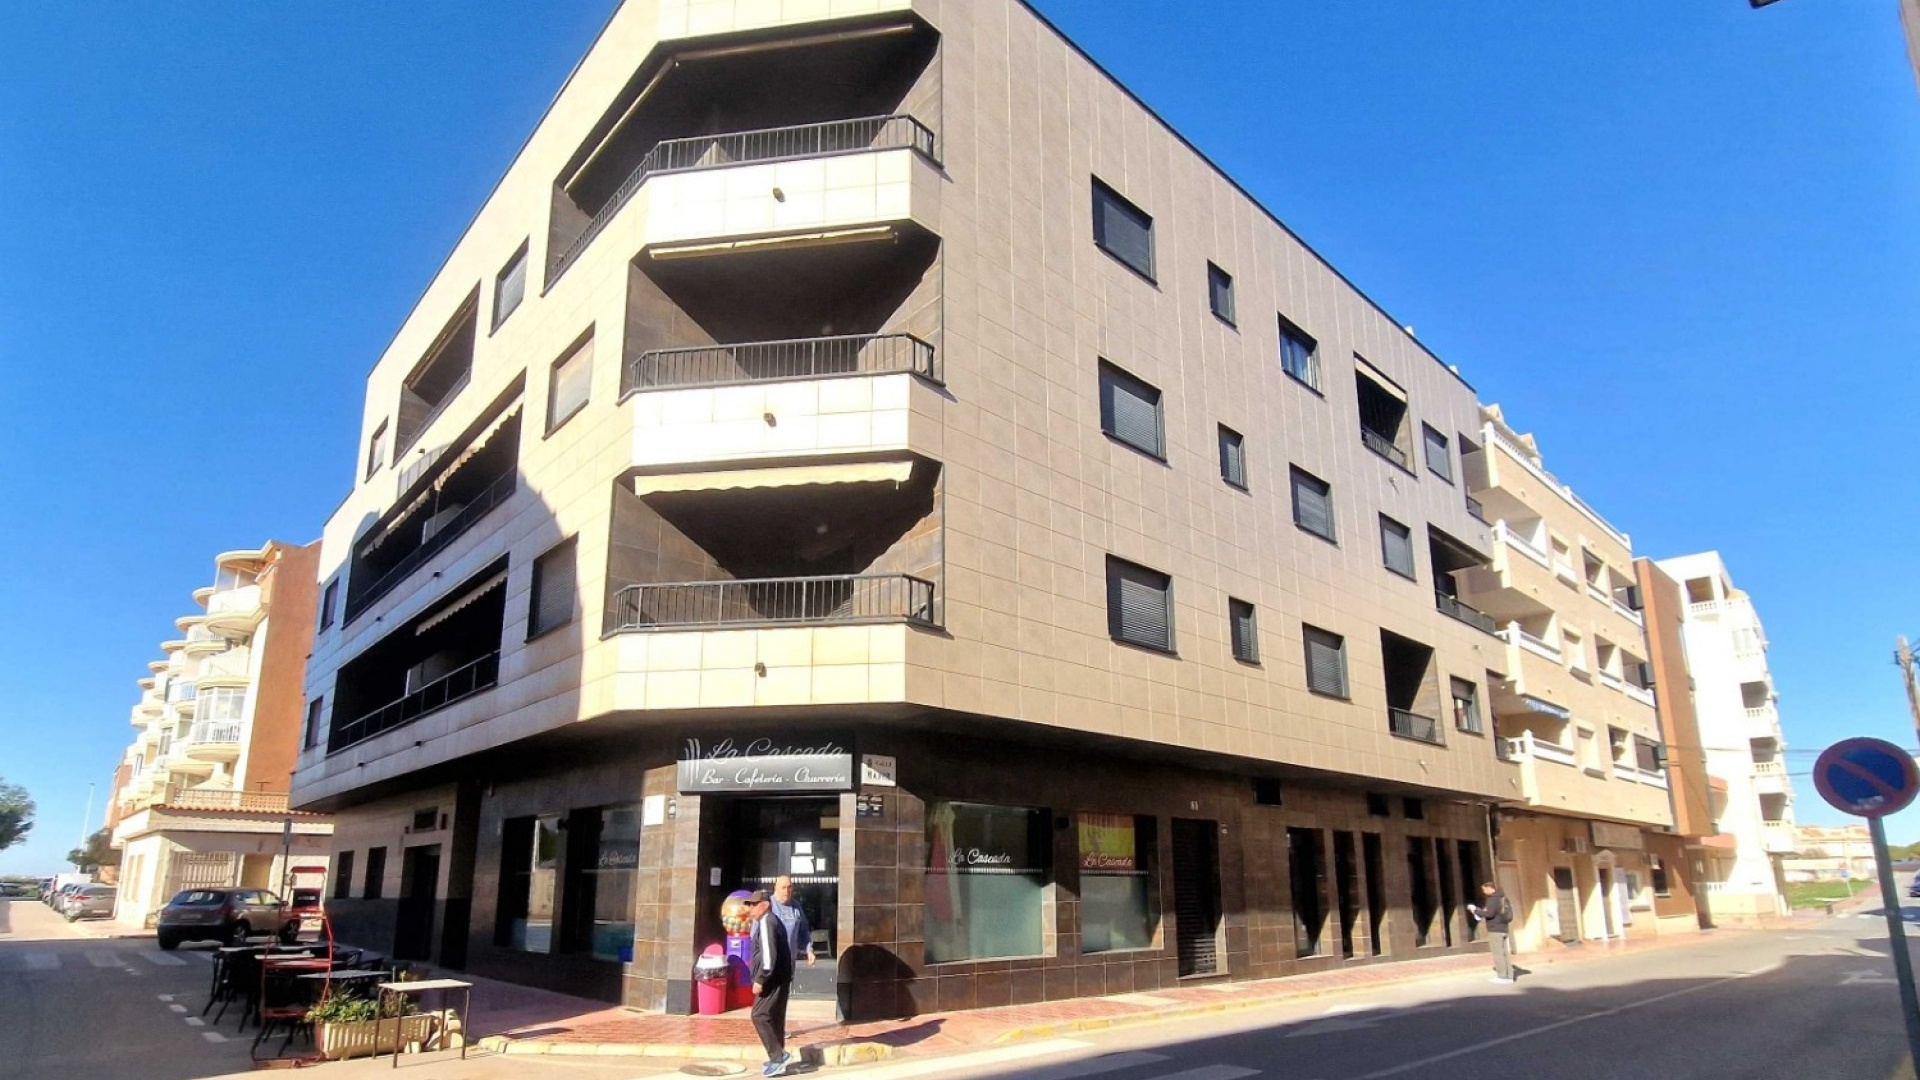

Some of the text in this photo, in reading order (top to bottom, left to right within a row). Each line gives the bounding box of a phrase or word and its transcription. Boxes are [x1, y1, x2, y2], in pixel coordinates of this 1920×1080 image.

[705, 737, 844, 764] La Cascada
[701, 769, 724, 784] Bar
[967, 848, 1011, 865] Cascada
